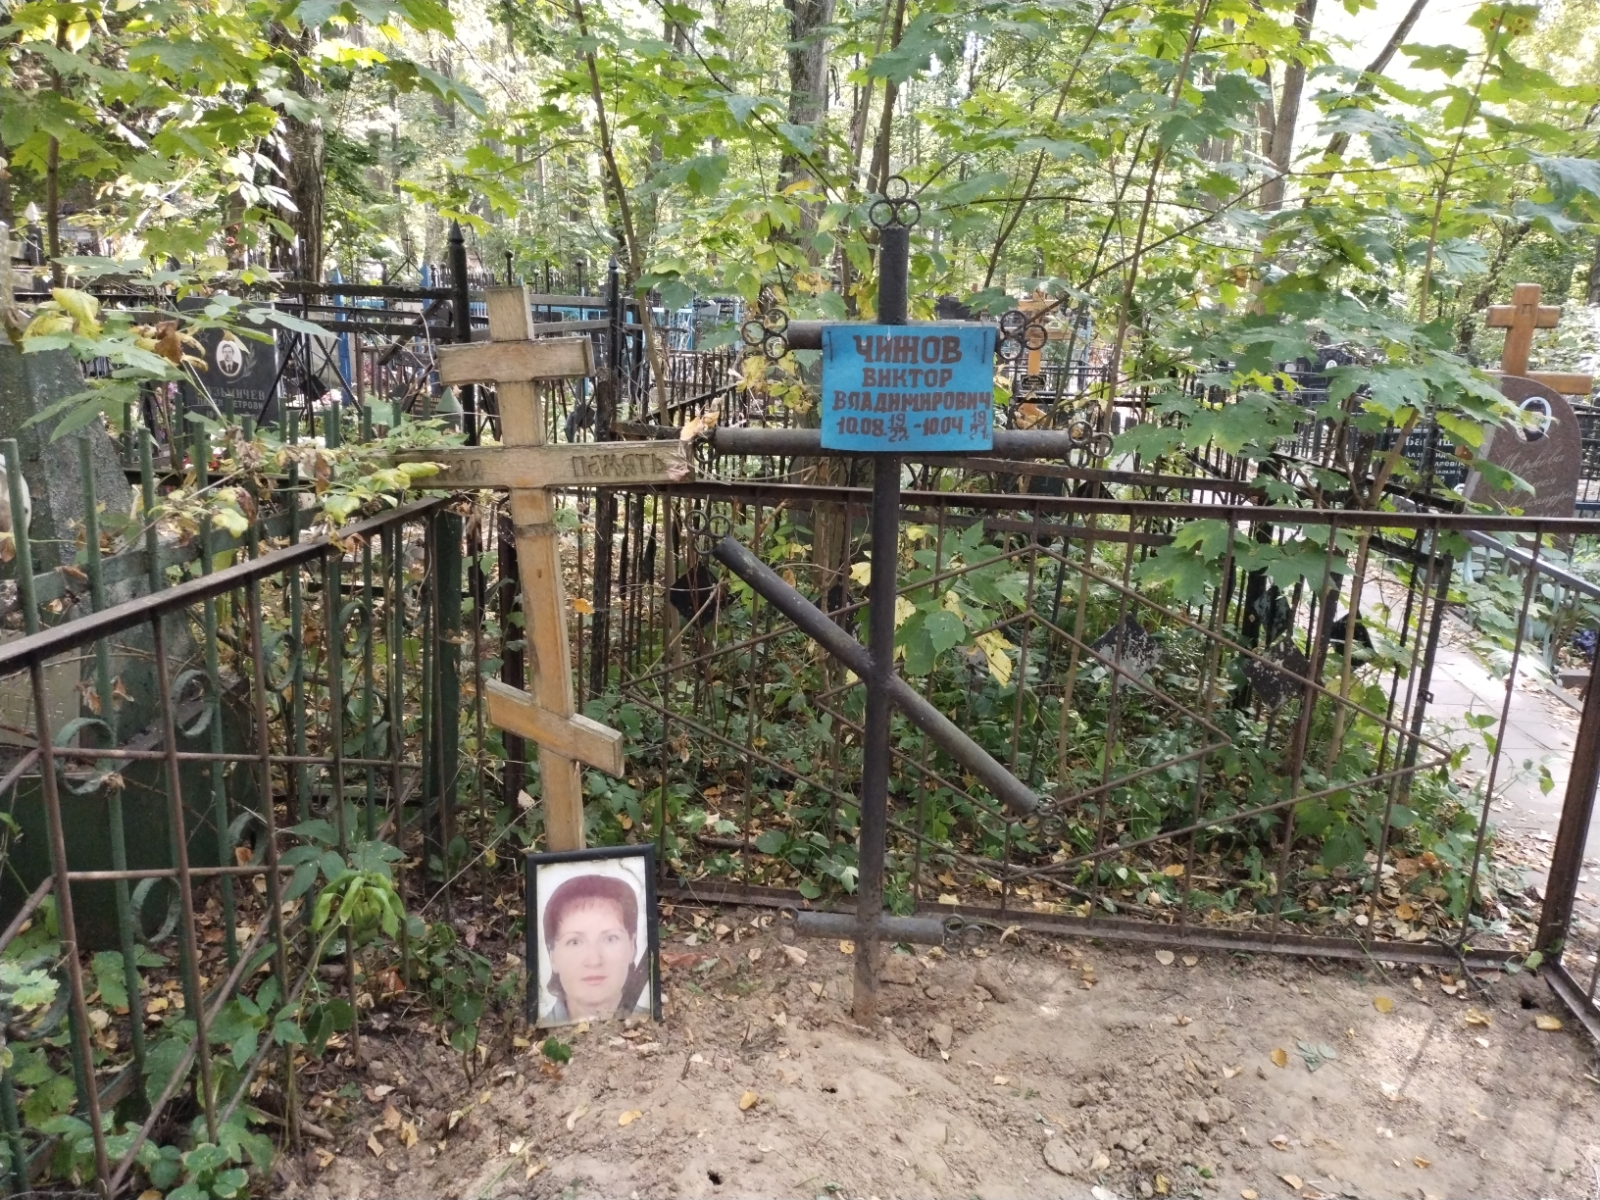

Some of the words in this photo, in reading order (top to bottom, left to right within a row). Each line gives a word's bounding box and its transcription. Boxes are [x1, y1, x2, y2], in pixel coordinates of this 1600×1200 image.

[852, 335, 963, 364] ЧИЖОВ
[862, 367, 953, 388] ВИКТОР
[206, 386, 266, 401] УЗЬМИЧЕВ
[832, 390, 992, 413] ВЛАДИМИРОВИЧ
